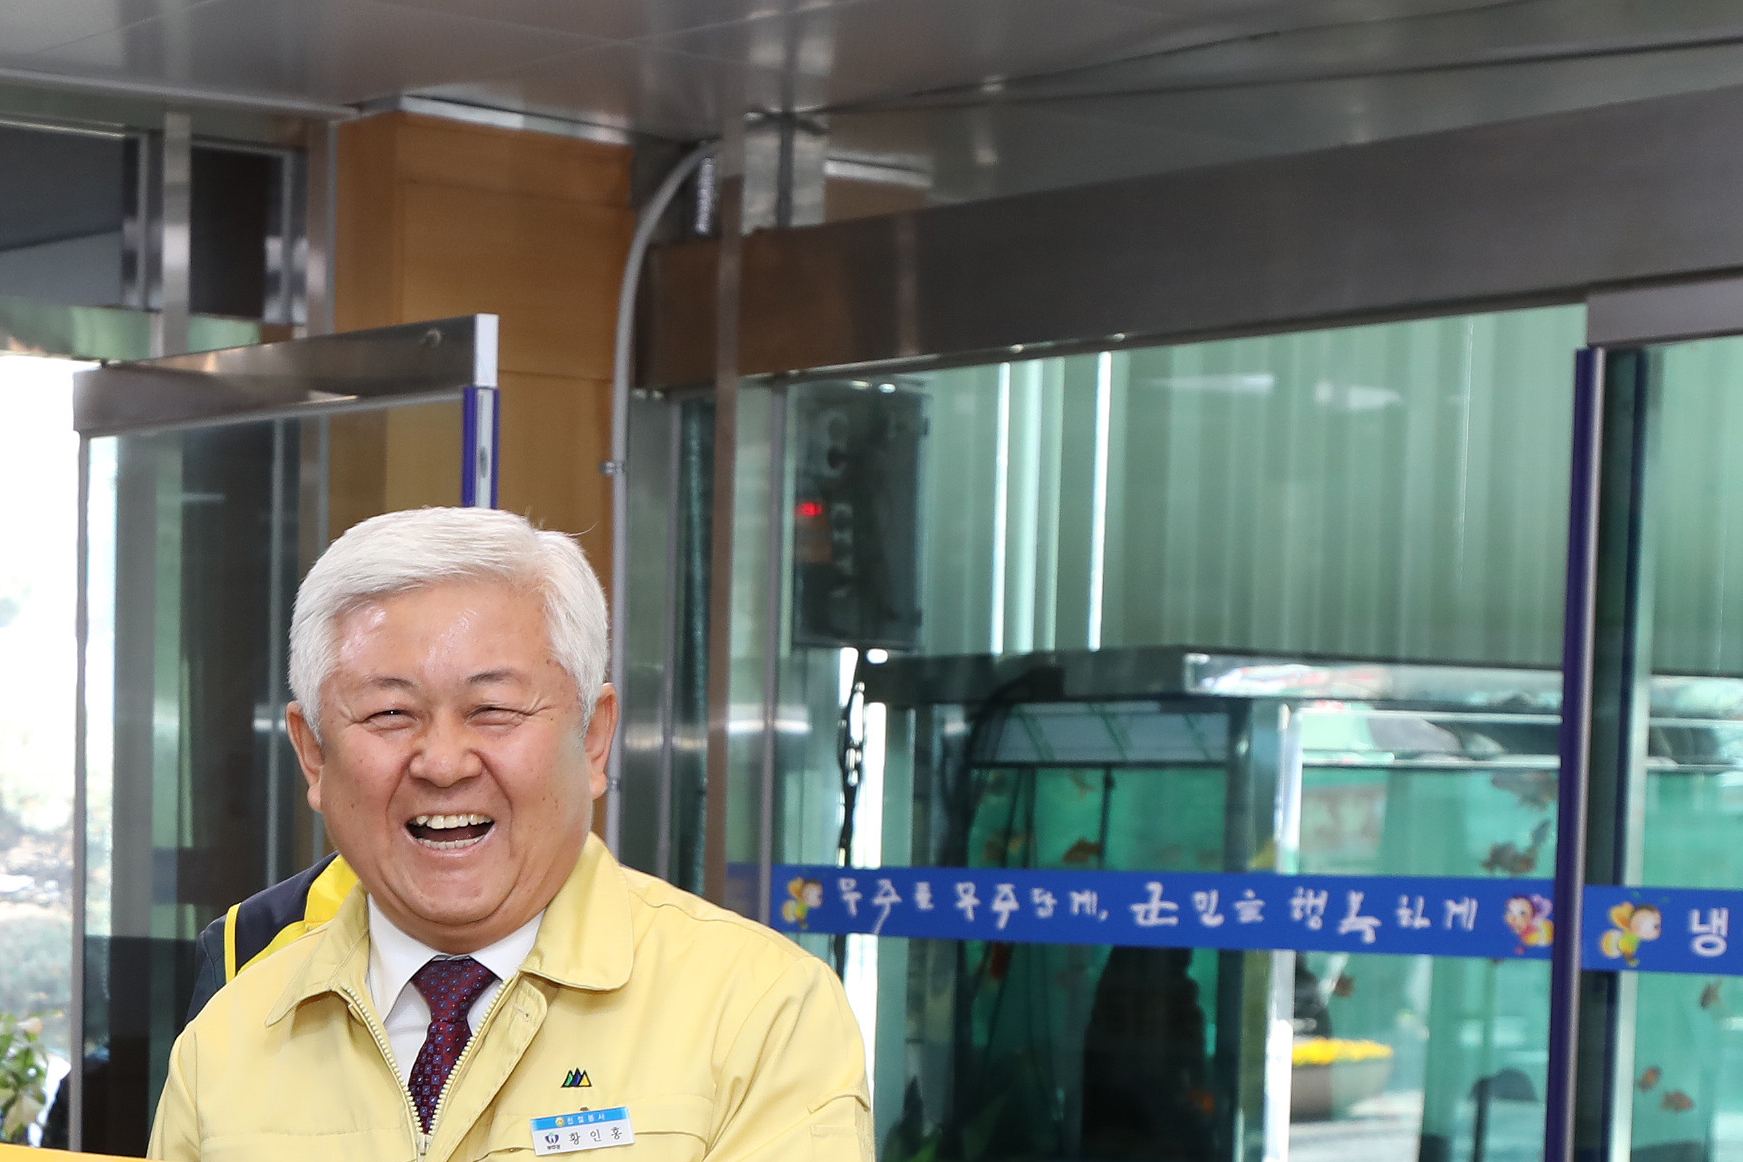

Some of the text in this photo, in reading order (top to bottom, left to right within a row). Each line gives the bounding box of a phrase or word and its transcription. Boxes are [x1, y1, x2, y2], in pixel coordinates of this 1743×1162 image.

[1129, 881, 1266, 928] 군민을
[1290, 885, 1479, 944] 행복하게
[1691, 906, 1730, 958] 냉
